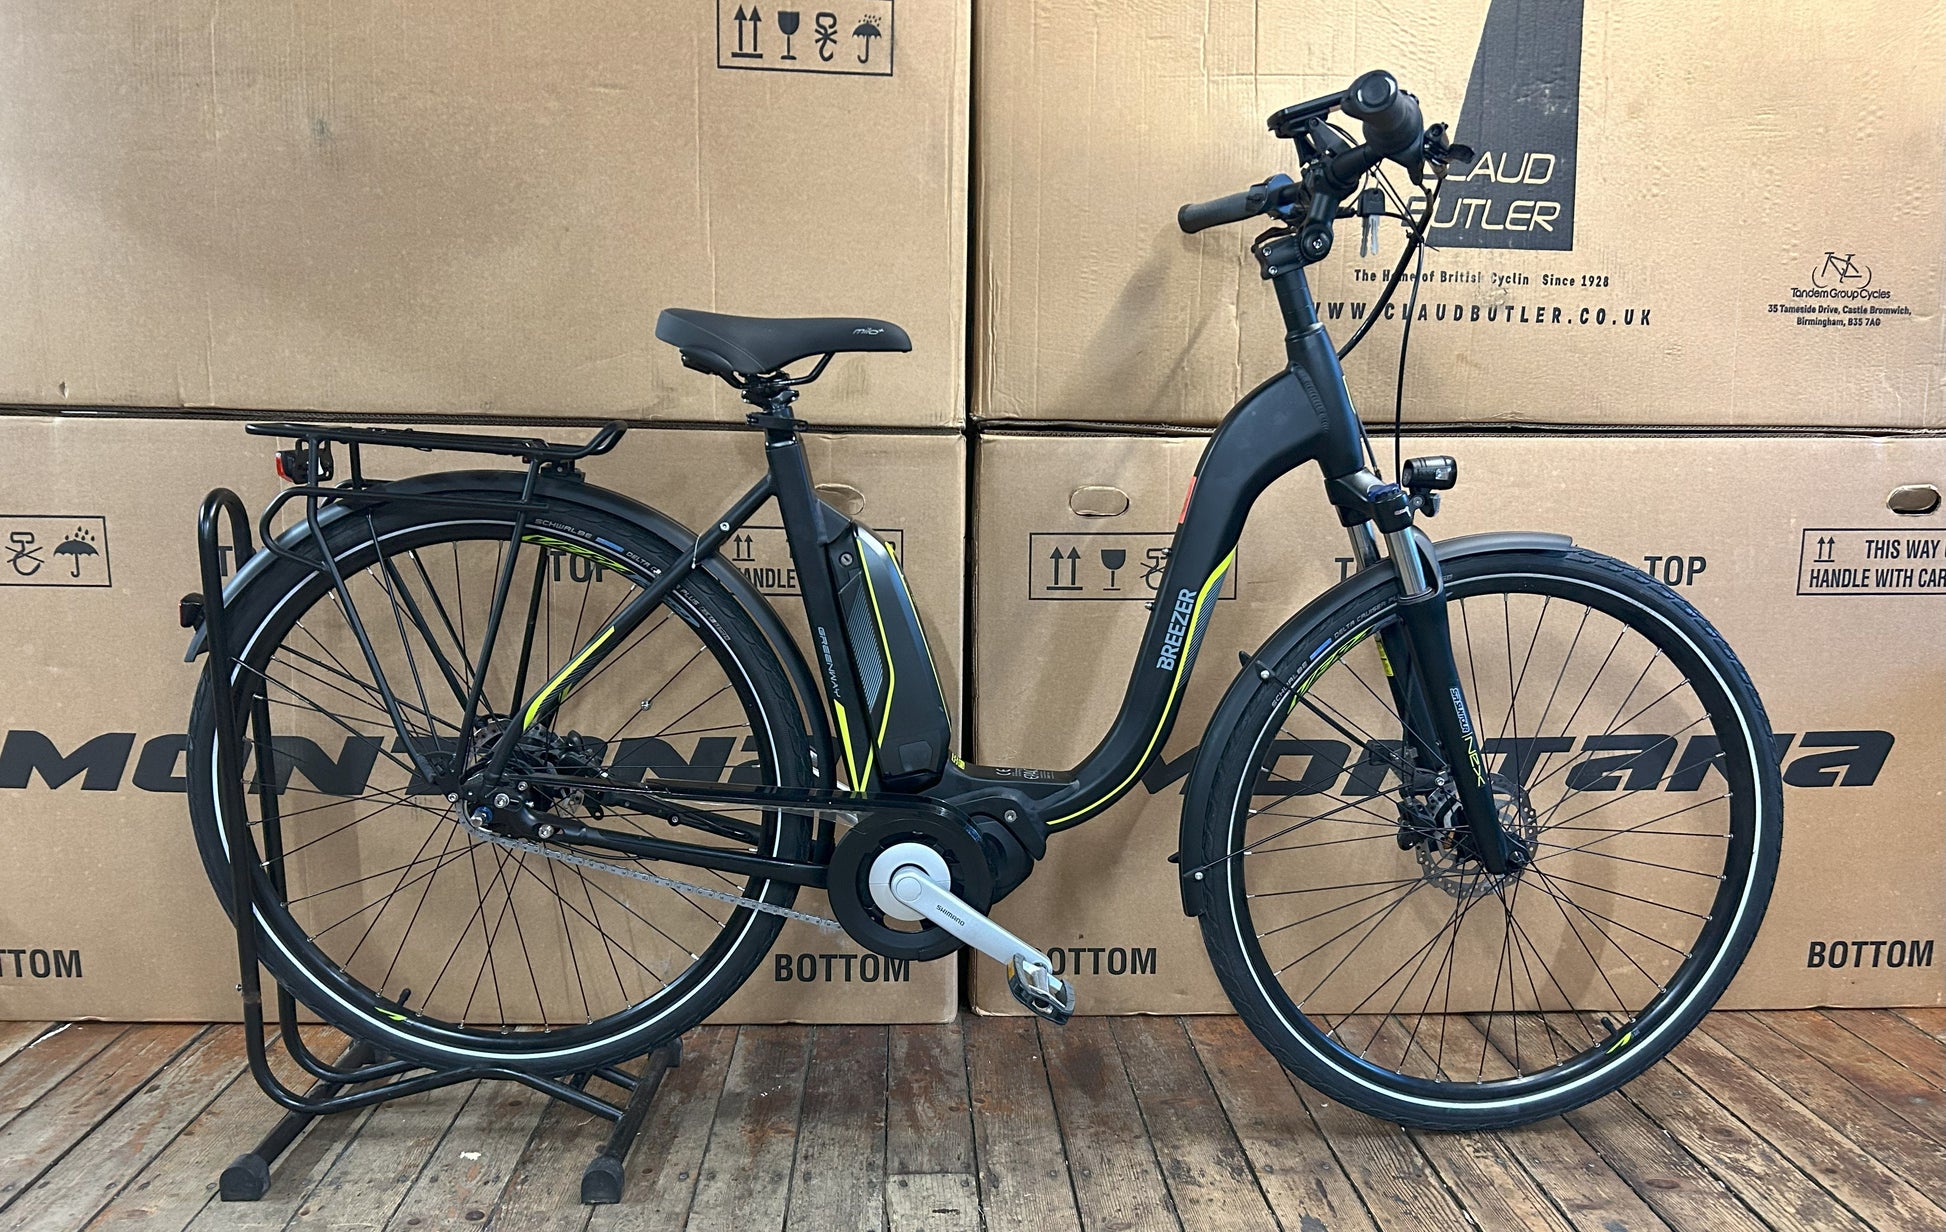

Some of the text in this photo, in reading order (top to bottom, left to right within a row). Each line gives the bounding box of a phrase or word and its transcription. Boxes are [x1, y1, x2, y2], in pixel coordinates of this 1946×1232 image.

[1422, 151, 1556, 185] LAUD
[1354, 269, 1377, 282] The
[1382, 269, 1416, 282] Hme
[1421, 270, 1435, 282] of
[1542, 273, 1575, 286] Since
[1580, 274, 1610, 287] 1928
[1790, 287, 1891, 300] Tandem Group Cycles
[1768, 304, 1912, 316] 35 Tameside Drive, Castle Bromwich,
[1796, 317, 1846, 328] Birmingham,
[1847, 318, 1863, 327] B35
[534, 518, 593, 540] SCHWALBE
[1865, 539, 1941, 559] THIS WAY
[1643, 555, 1707, 587] TOP
[1809, 568, 1871, 588] HANDLE
[1875, 568, 1914, 588] WITH
[1156, 588, 1198, 672] BREEZER
[817, 626, 841, 698] GREENWAY
[935, 904, 966, 927] SHIMANO
[1036, 947, 1157, 976] OTTOM
[1807, 940, 1935, 969] BOTTOM
[774, 953, 910, 983] BOTTOM
